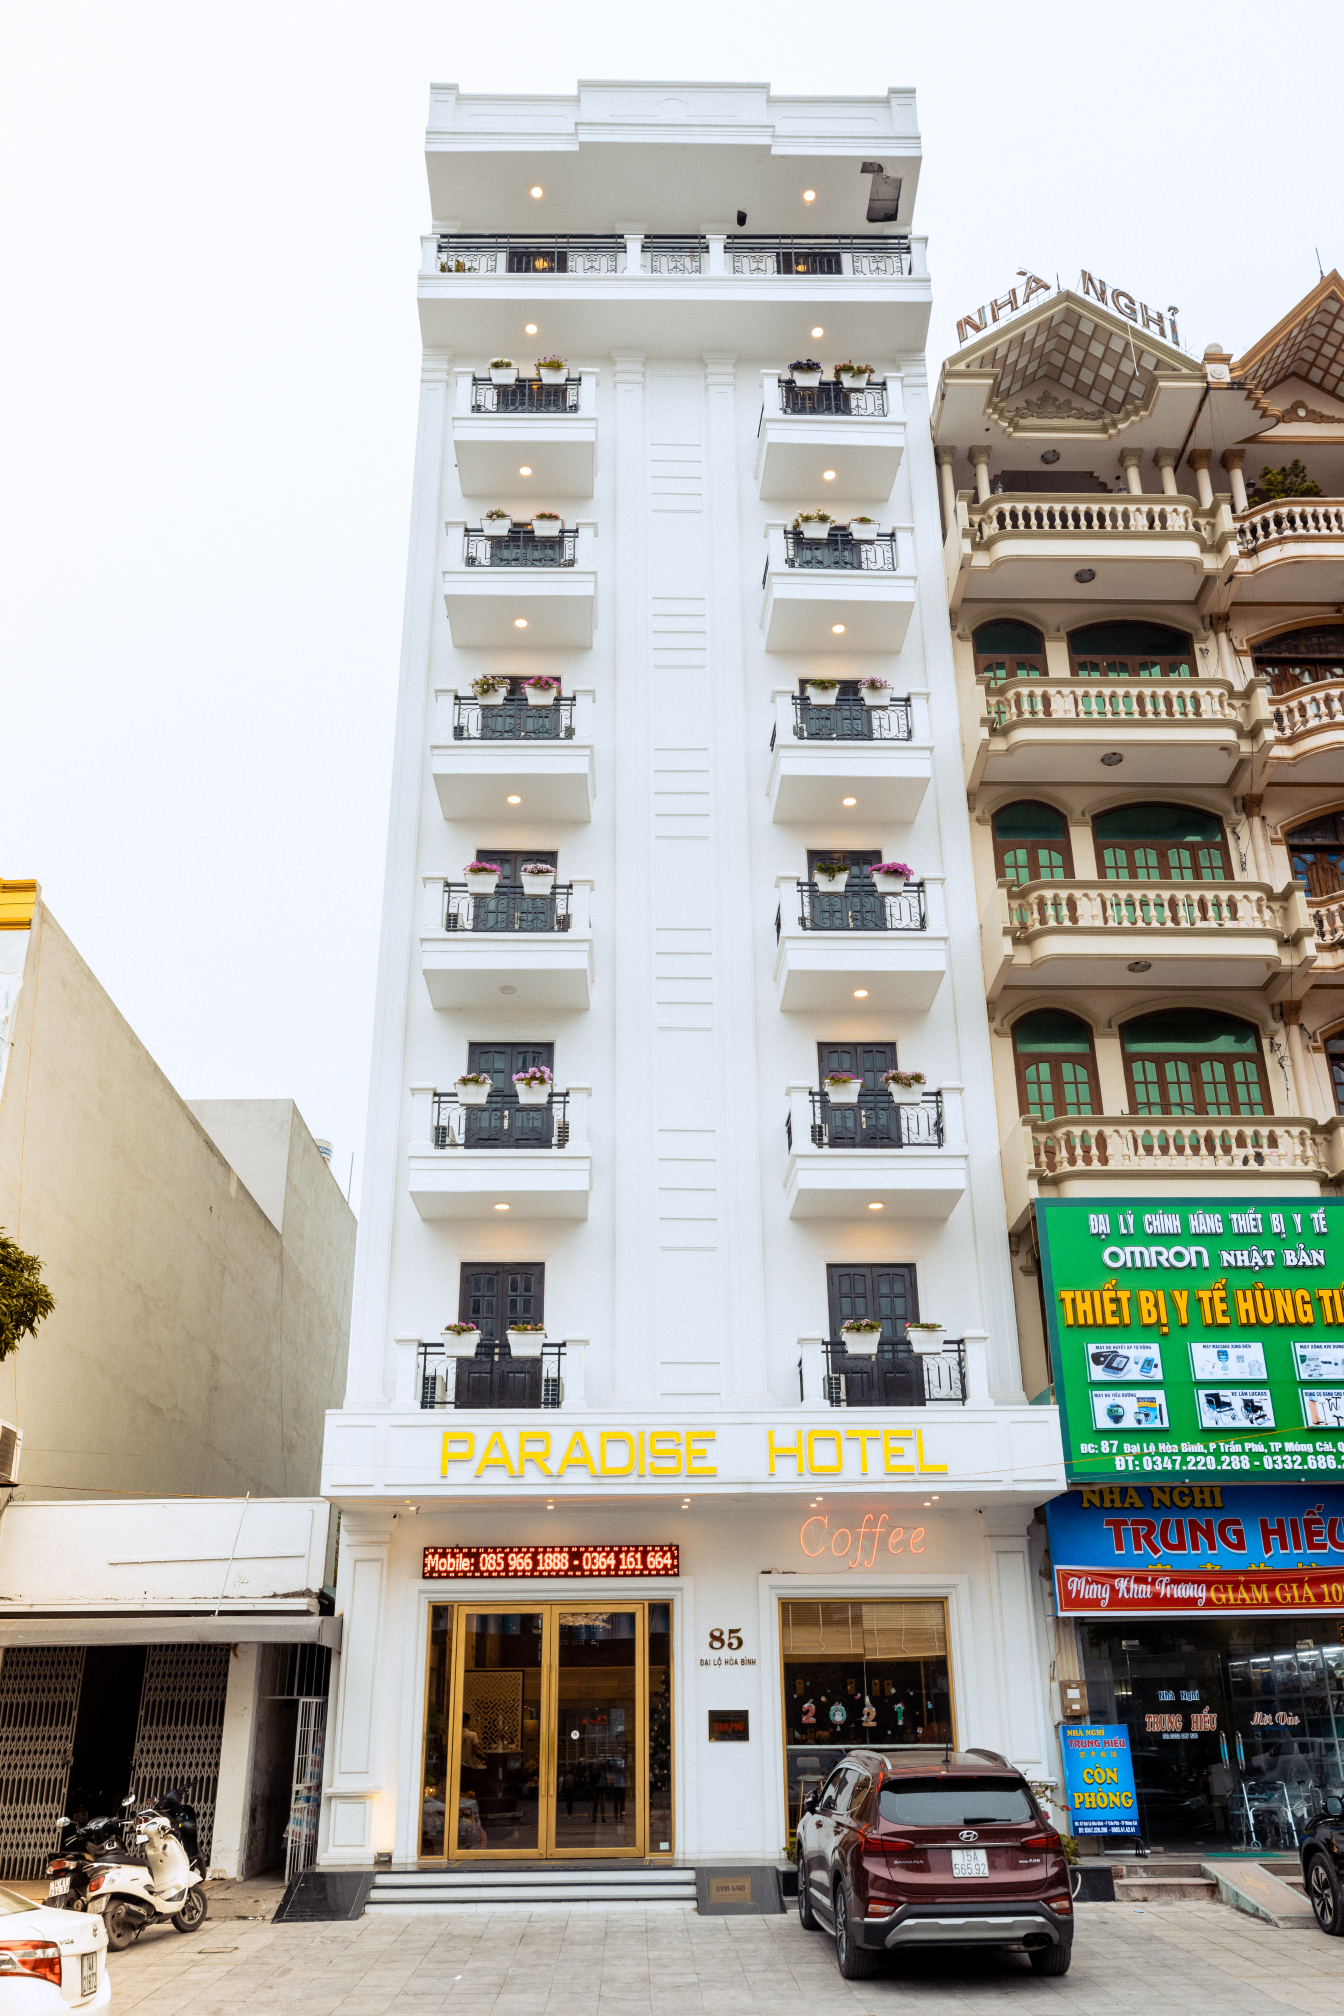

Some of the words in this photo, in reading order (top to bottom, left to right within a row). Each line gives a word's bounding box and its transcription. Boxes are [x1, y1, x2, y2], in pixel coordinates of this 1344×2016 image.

[956, 267, 1052, 343] NHÀ
[1081, 269, 1180, 346] NGHỈ
[1088, 1213, 1111, 1239] ĐẠI
[1118, 1210, 1134, 1235] LÝ
[1143, 1209, 1182, 1235] CHÍNH
[1189, 1210, 1224, 1235] HÃNG
[1229, 1207, 1263, 1235] THIẾT
[1270, 1212, 1287, 1239] BỊ
[1292, 1213, 1302, 1234] Y
[1310, 1207, 1328, 1235] TẾ
[1102, 1245, 1210, 1269] OMRON
[1219, 1245, 1276, 1272] NHẬT
[1282, 1243, 1326, 1269] BẢN
[1058, 1279, 1132, 1328] THIẾT
[1138, 1289, 1169, 1335] BỊ
[1172, 1290, 1189, 1327] Y
[1196, 1278, 1231, 1327] TẾ
[1234, 1282, 1315, 1327] HÙNG
[440, 1430, 718, 1478] PARADISE
[766, 1428, 949, 1475] HOTEL
[1080, 1443, 1098, 1454] ĐC:
[1100, 1440, 1118, 1454] 87
[1123, 1443, 1140, 1455] Đại
[1143, 1442, 1156, 1455] Lộ
[1158, 1442, 1178, 1453] Hòa
[1209, 1442, 1216, 1453] P
[1269, 1442, 1282, 1453] TP
[1284, 1442, 1313, 1454] Móng
[1115, 1456, 1140, 1471] ĐT:
[1142, 1455, 1250, 1471] 0347.220.288
[799, 1513, 927, 1570] Coffee
[1103, 1517, 1248, 1559] TRUNG
[427, 1553, 475, 1572] Mobile:
[479, 1553, 504, 1571] 085
[508, 1553, 532, 1571] 966
[536, 1552, 569, 1571] 1888
[582, 1552, 615, 1570] 0364
[620, 1552, 643, 1570] 161
[646, 1552, 672, 1569] 664
[1068, 1577, 1110, 1607] Mừng
[1115, 1575, 1152, 1599] Khai
[1155, 1577, 1206, 1606] Trương
[1210, 1576, 1272, 1605] GIẢM
[1276, 1577, 1316, 1604] GIÁ
[1320, 1583, 1344, 1603] 10
[708, 1627, 744, 1651] 85
[1158, 1690, 1176, 1701] Nhà
[1180, 1689, 1200, 1702] Nghỉ
[1145, 1714, 1183, 1732] TRUNG
[1191, 1706, 1218, 1732] HIẾU
[1066, 1728, 1084, 1737] NHÀ
[1085, 1727, 1105, 1736] NGHỈ
[1068, 1739, 1101, 1750] TRUNG
[1104, 1736, 1126, 1749] HIẾU
[1082, 1763, 1118, 1785] CÒN
[1073, 1787, 1134, 1810] PHÒNG
[960, 1850, 978, 1863] 15A
[954, 1863, 987, 1876] 565.92
